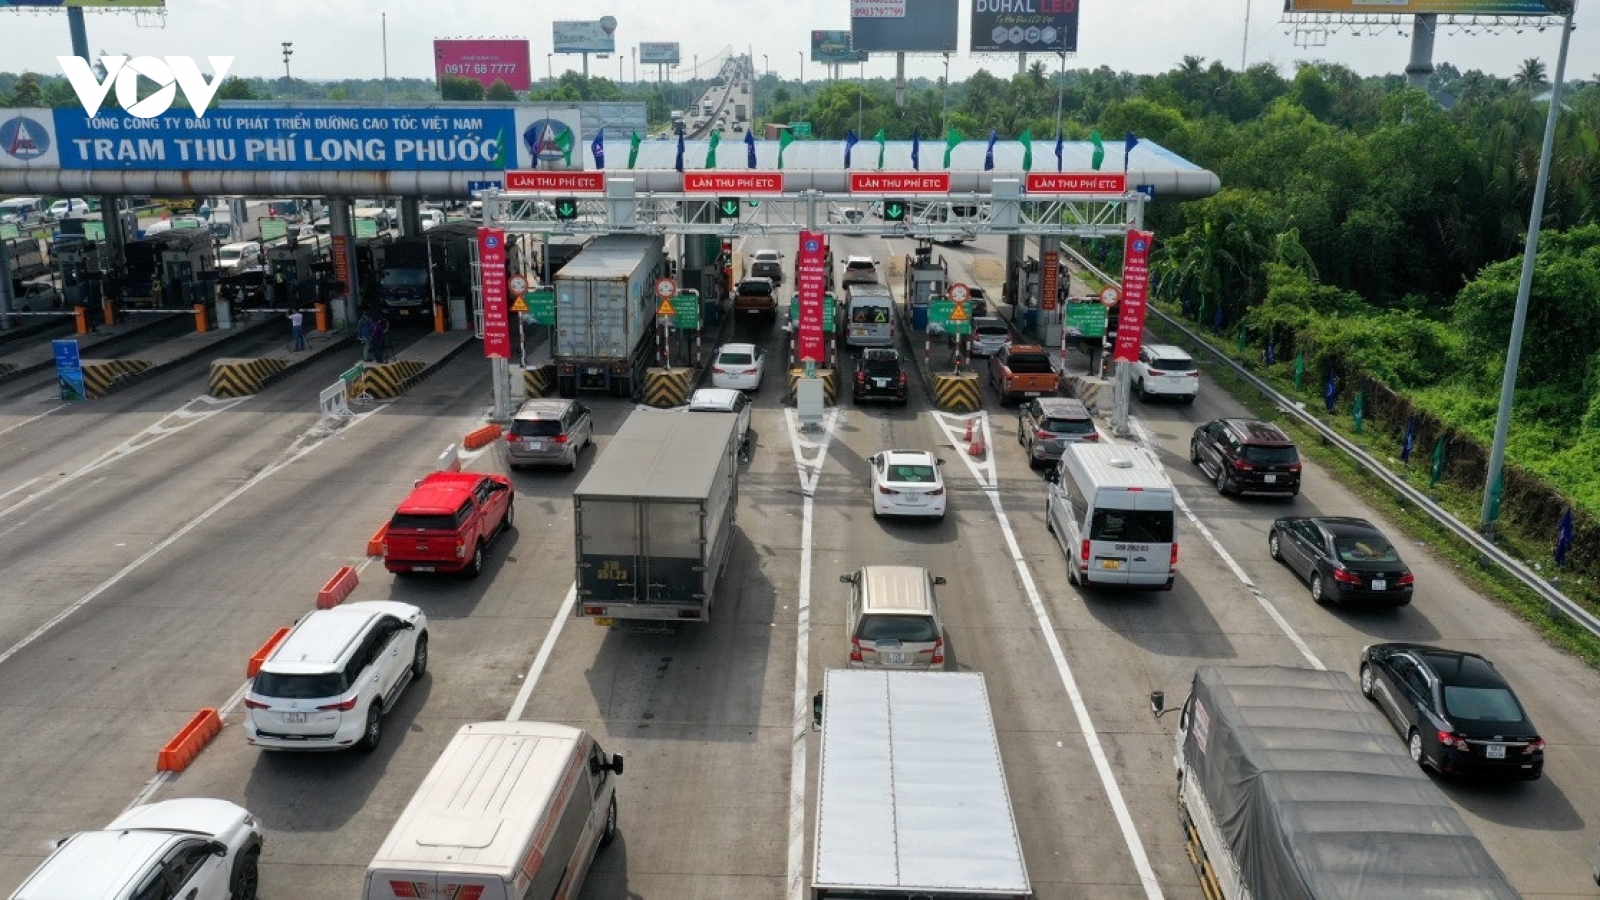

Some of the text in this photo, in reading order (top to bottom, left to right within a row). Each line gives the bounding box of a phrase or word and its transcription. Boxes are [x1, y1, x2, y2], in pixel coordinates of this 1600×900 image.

[1041, 0, 1077, 13] LED
[444, 64, 516, 74] 0917 68 7777
[164, 117, 180, 130] TY
[216, 115, 232, 130] TƯ
[236, 114, 269, 130] PHÁT
[273, 112, 311, 130] TRIỂN
[314, 114, 359, 130] ĐƯỜNG
[362, 118, 389, 130] CAO
[392, 114, 418, 130] TỐC
[422, 114, 449, 132] VIỆT
[453, 118, 483, 130] NAM
[72, 132, 500, 166] TRẠM THU PHÍ LONG PHƯỚC
[513, 176, 596, 187] LÀN THU PHÍ ETC
[692, 177, 774, 188] LÀN THU PHÍ ETC
[859, 177, 942, 188] LÀN THU PHÍ ETC
[1034, 178, 1118, 189] LÀN THU PHÍ ETC
